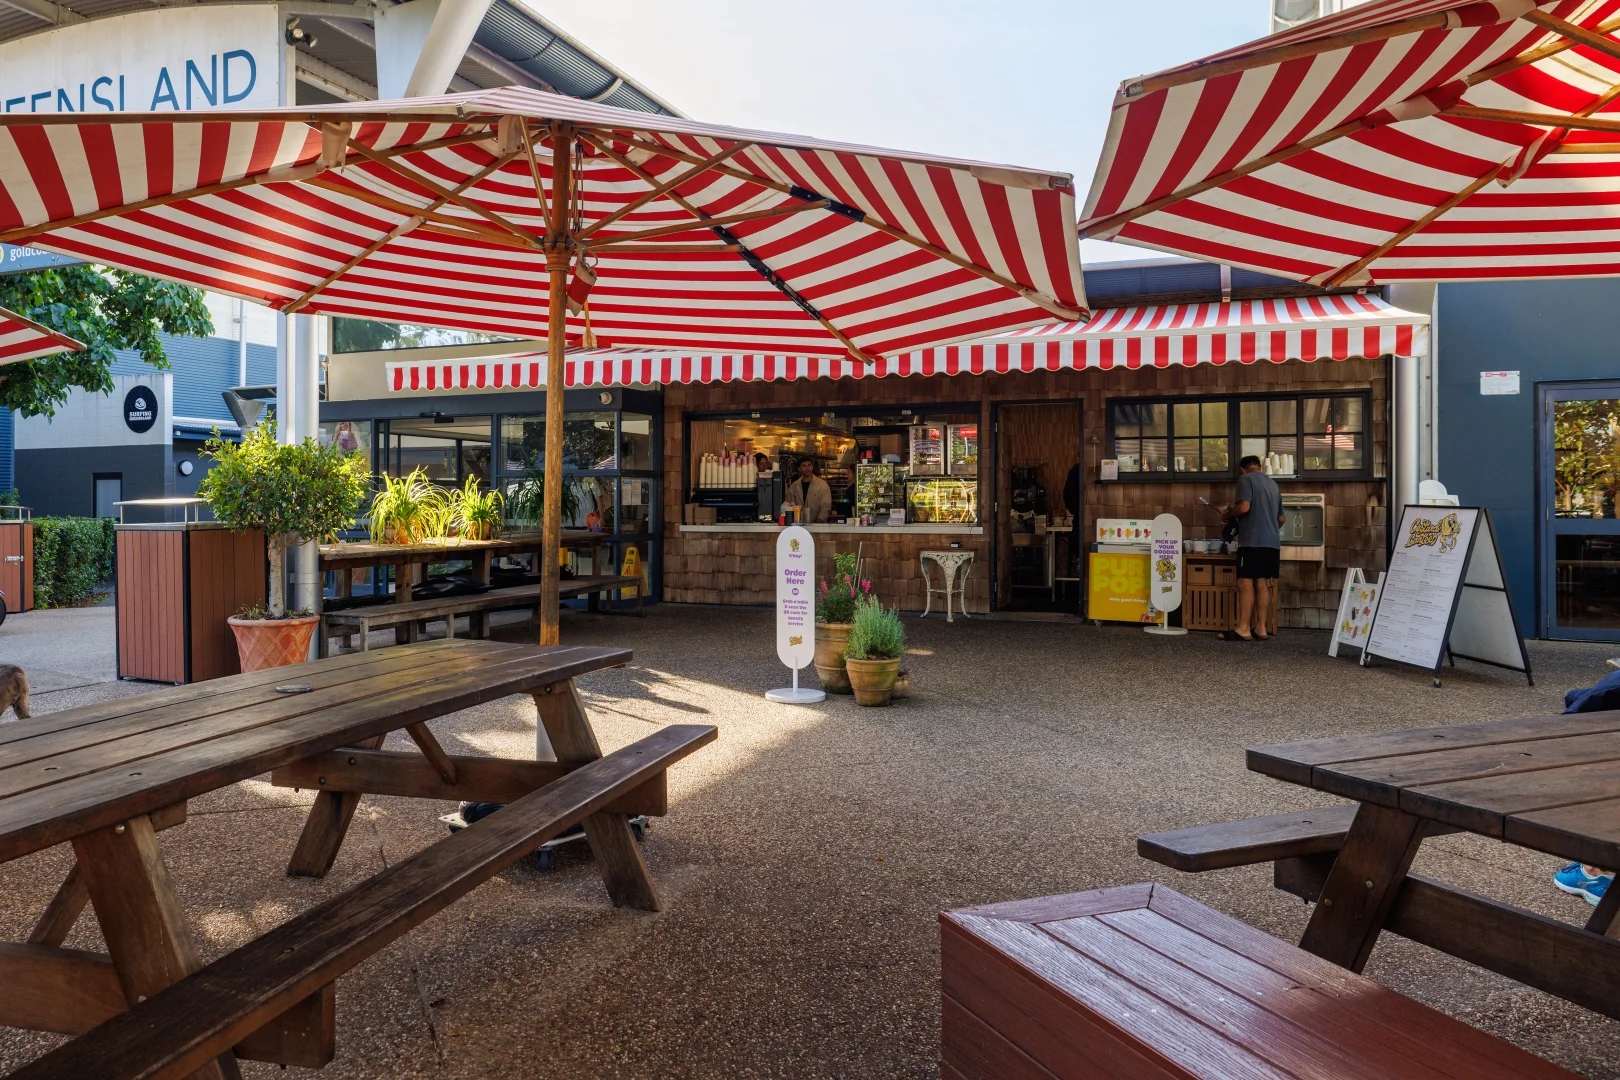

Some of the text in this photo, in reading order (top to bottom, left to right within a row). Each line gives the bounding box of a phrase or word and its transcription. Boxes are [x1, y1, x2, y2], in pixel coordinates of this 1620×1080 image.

[0, 49, 257, 113] NSLAND
[1409, 518, 1443, 535] Custard
[1404, 533, 1438, 548] Canteen
